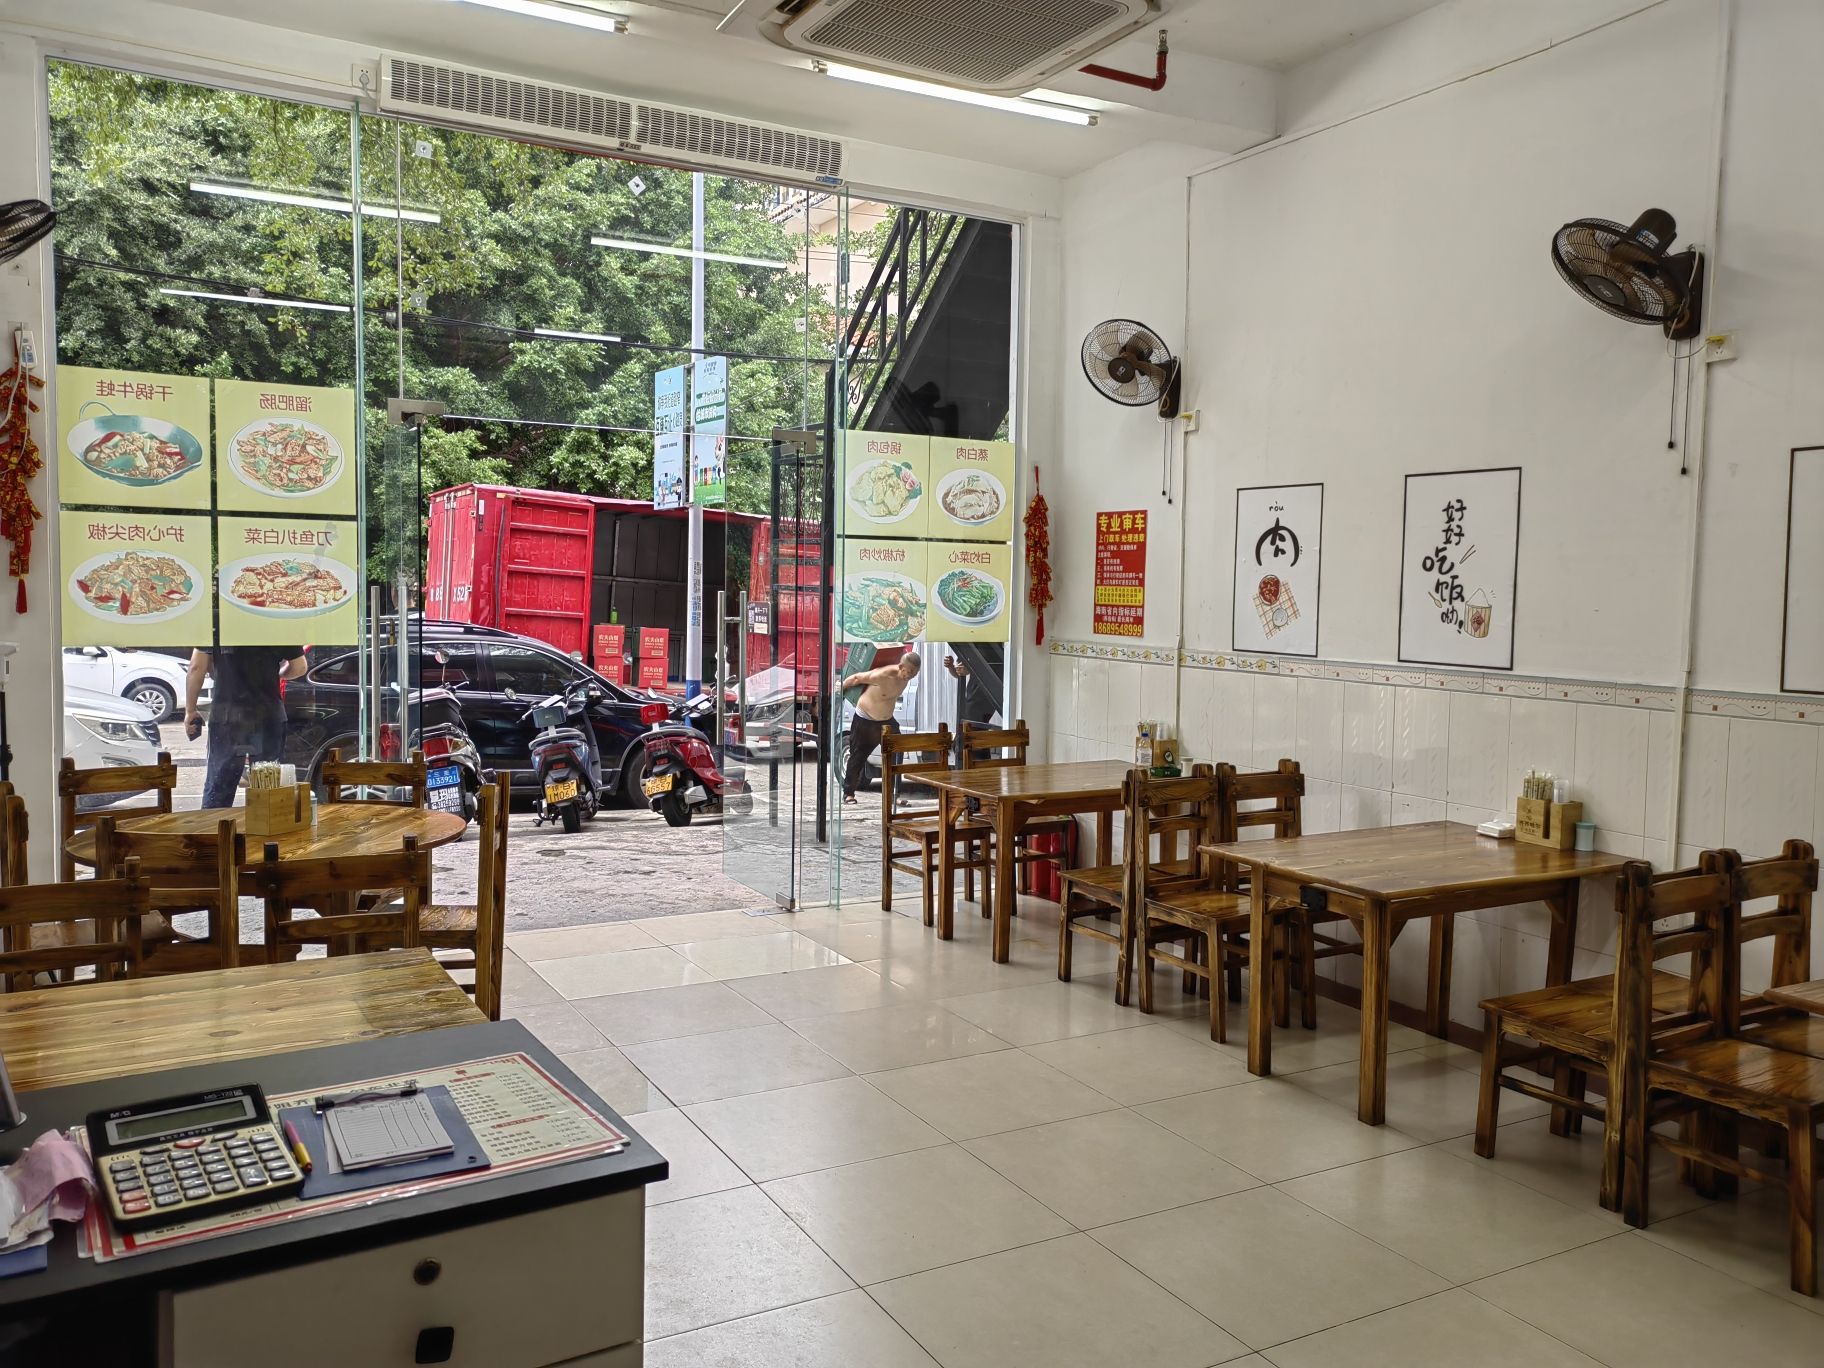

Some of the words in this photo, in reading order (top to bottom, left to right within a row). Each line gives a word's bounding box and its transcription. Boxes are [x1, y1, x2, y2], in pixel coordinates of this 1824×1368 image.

[1098, 512, 1145, 532] 专业审车
[1255, 517, 1299, 567] 肉
[1095, 622, 1142, 636] 18689548999
